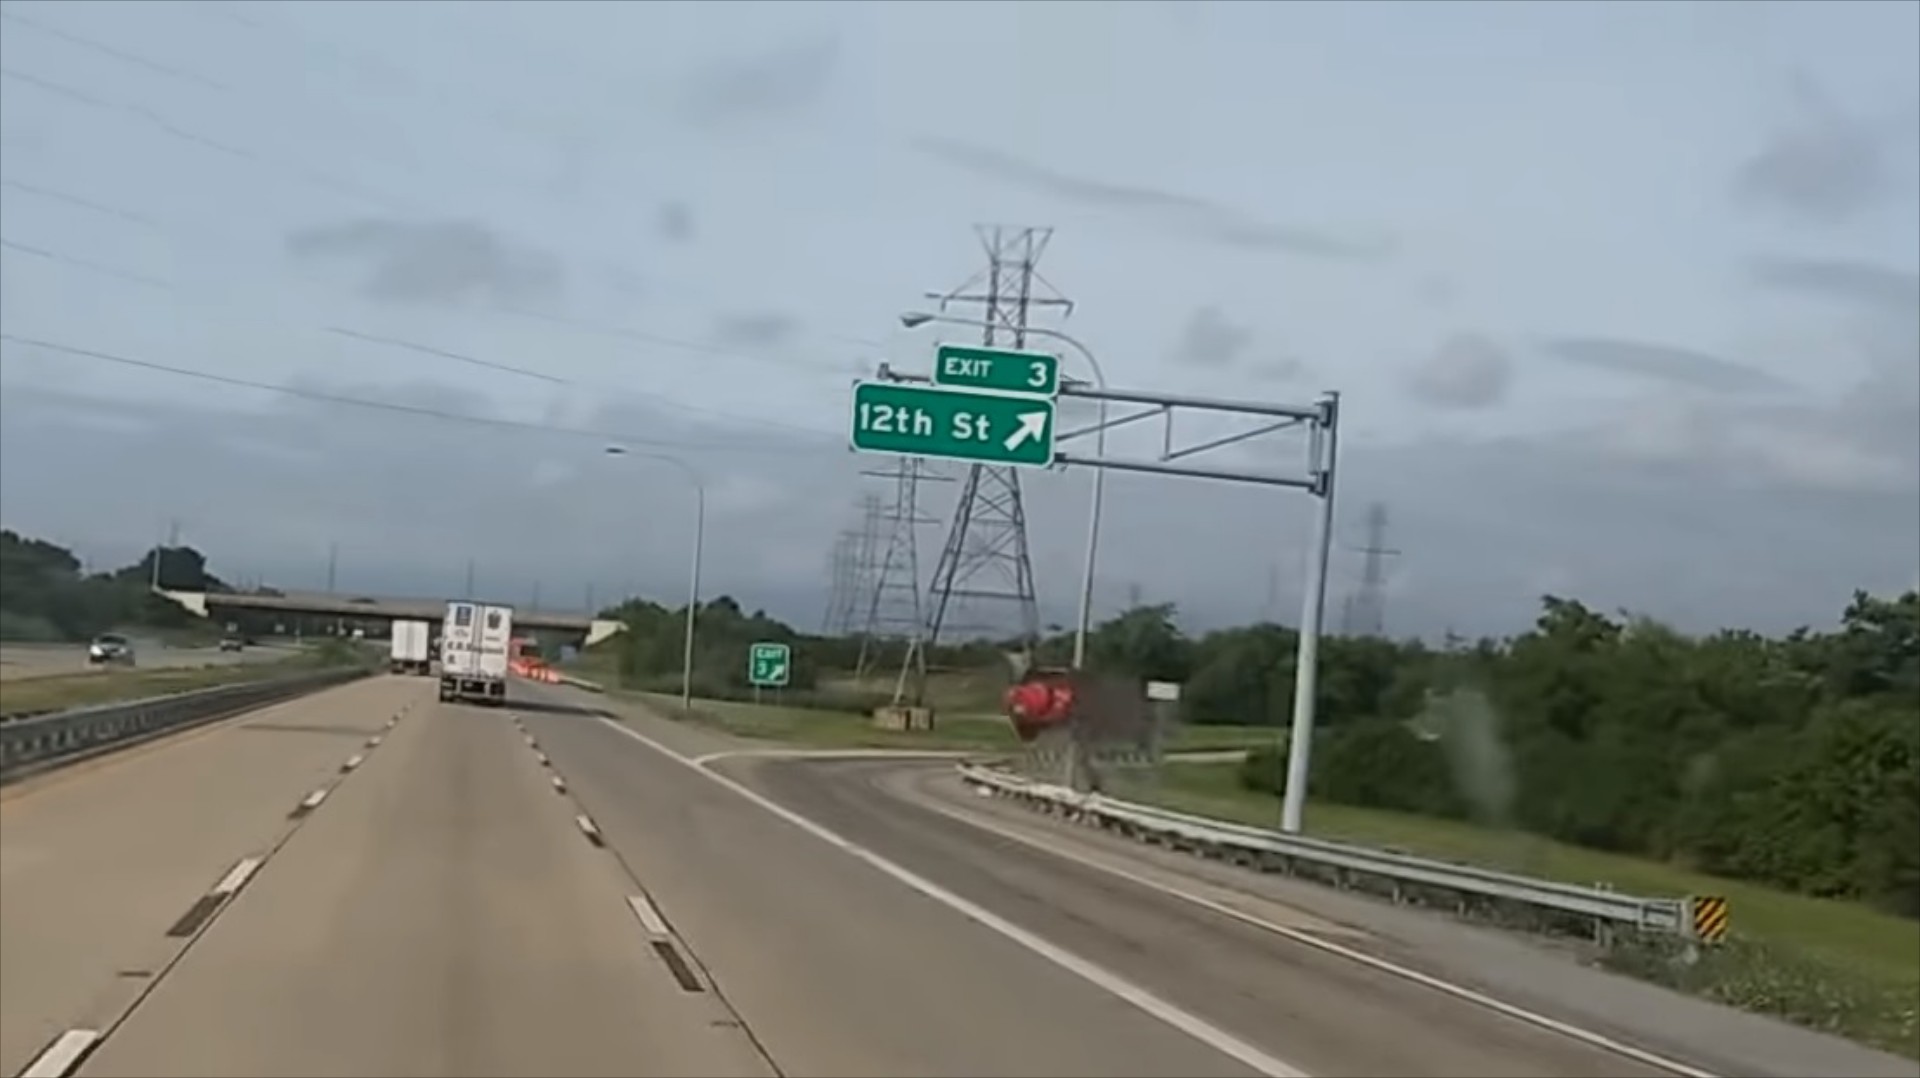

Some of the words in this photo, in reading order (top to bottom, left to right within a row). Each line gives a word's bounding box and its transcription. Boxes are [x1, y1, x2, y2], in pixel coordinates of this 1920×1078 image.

[944, 357, 993, 378] EXIT
[1027, 362, 1048, 387] 3
[859, 403, 933, 436] 12th
[951, 411, 991, 441] St
